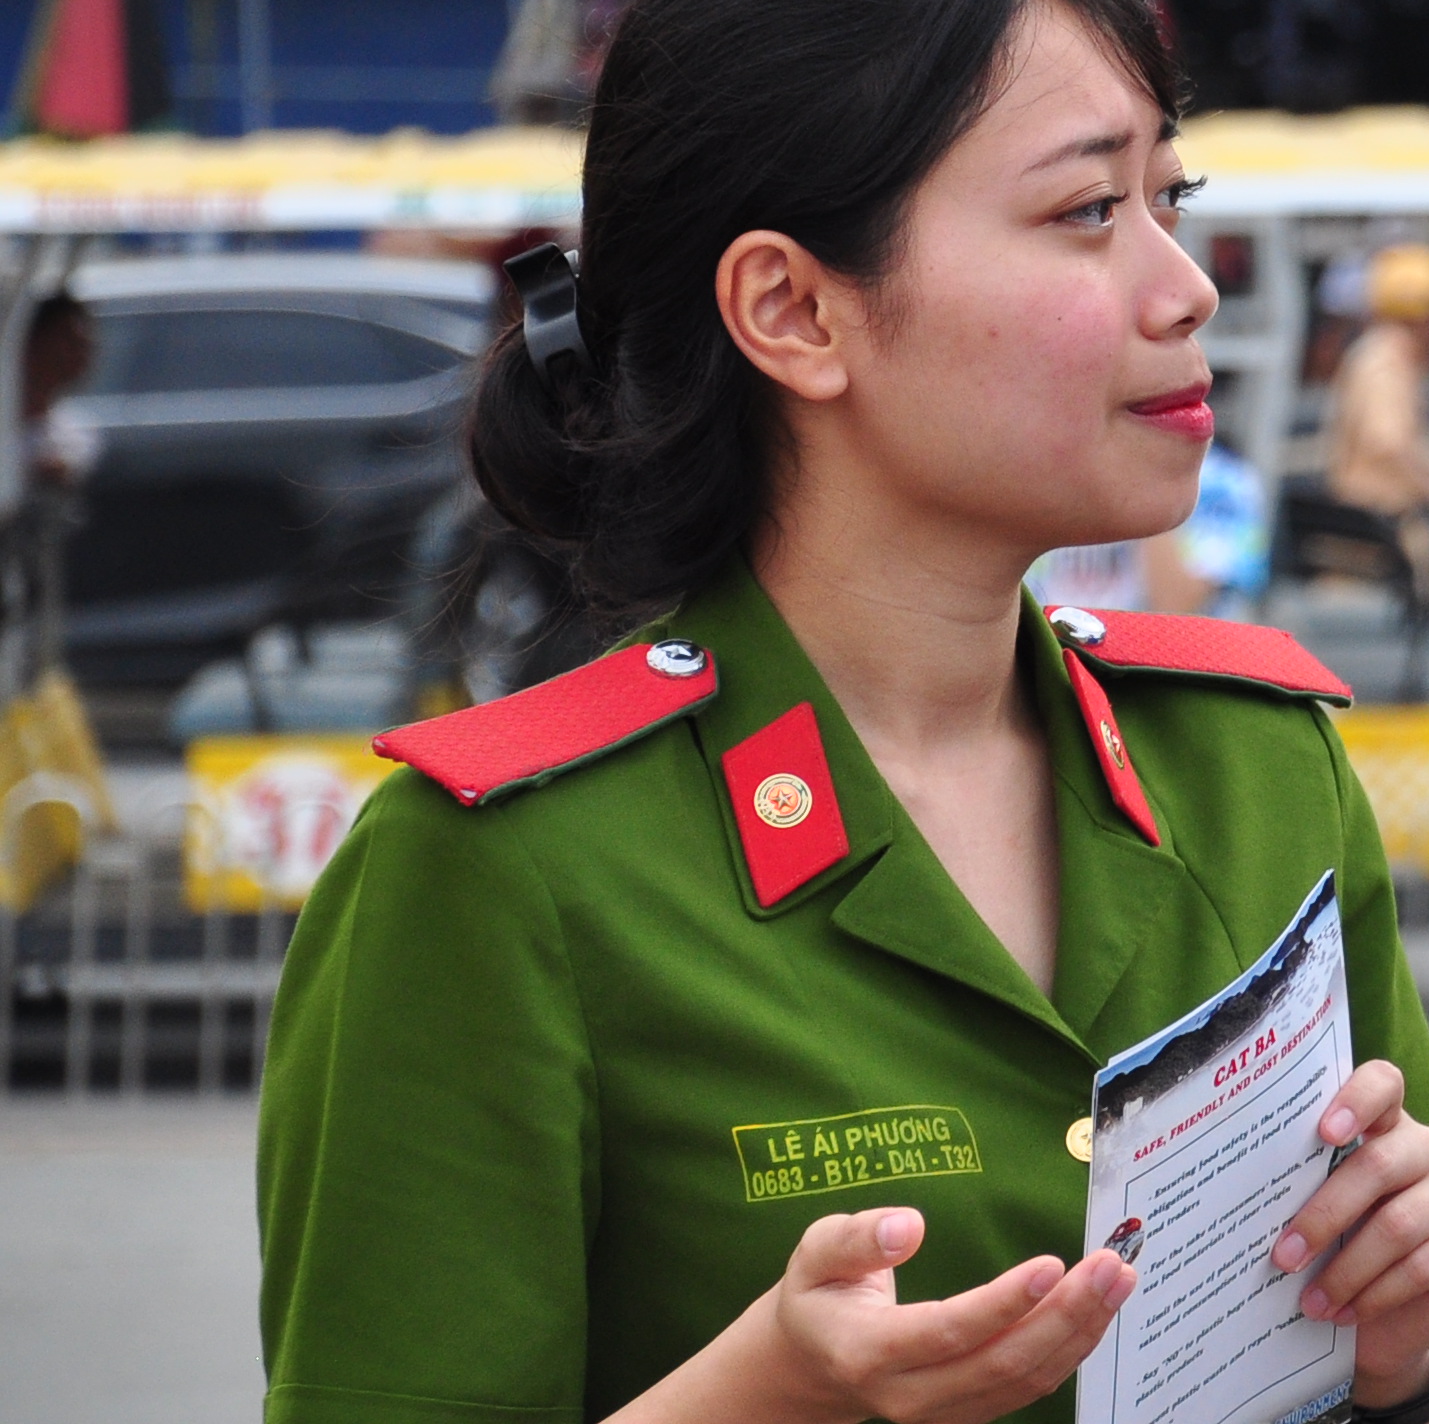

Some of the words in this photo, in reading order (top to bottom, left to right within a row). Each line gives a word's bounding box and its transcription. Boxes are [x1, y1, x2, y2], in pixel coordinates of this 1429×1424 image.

[1133, 1136, 1166, 1162] SAFE,
[1170, 1093, 1226, 1140] FRIENDLY
[1228, 1075, 1251, 1101] AND
[1253, 1055, 1278, 1081] COSY
[1280, 994, 1333, 1060] DESTINATION
[1213, 1047, 1250, 1087] CAT
[1254, 1028, 1277, 1058] BA
[752, 1166, 804, 1197] 0683
[825, 1155, 869, 1186] B12
[888, 1149, 926, 1174] D41
[940, 1145, 976, 1169] T32
[768, 1130, 805, 1163] LÊ
[813, 1127, 839, 1157] ÁI
[845, 1117, 950, 1151] PHƯƠNG
[1147, 1185, 1194, 1221] obligation
[1197, 1170, 1214, 1188] and
[1217, 1147, 1248, 1174] benefit
[1250, 1138, 1259, 1151] of
[1262, 1123, 1281, 1145] food
[1283, 1090, 1322, 1129] producers
[1154, 1166, 1196, 1199] Ensuring
[1199, 1149, 1219, 1172] food
[1221, 1131, 1248, 1153] safety
[1250, 1123, 1258, 1133] is
[1260, 1111, 1274, 1126] the
[1143, 1280, 1159, 1295] use
[1161, 1262, 1182, 1284] food
[1183, 1232, 1225, 1267] materials
[1227, 1222, 1237, 1235] of
[1238, 1206, 1261, 1226] clear
[1263, 1185, 1291, 1207] origin
[1146, 1221, 1164, 1240] and
[1167, 1199, 1200, 1226] traders
[1150, 1258, 1166, 1273] For
[1169, 1245, 1184, 1262] the
[1186, 1228, 1206, 1248] sake
[1208, 1219, 1217, 1232] of
[1305, 1146, 1325, 1164] only
[1138, 1330, 1162, 1351] sales
[1164, 1315, 1180, 1333] and
[1182, 1273, 1238, 1319] consumption
[1239, 1261, 1248, 1275] of
[1250, 1246, 1270, 1269] food
[1146, 1305, 1170, 1328] Limit
[1173, 1294, 1187, 1310] the
[1190, 1280, 1204, 1296] use
[1206, 1271, 1215, 1285] of
[1216, 1249, 1246, 1277] plastic
[1247, 1233, 1268, 1252] bags
[1270, 1226, 1279, 1236] in
[1135, 1379, 1165, 1407] plastic
[1166, 1349, 1204, 1383] products
[1142, 1367, 1159, 1383] Say
[1185, 1339, 1194, 1350] to
[1196, 1315, 1225, 1343] plastic
[1226, 1299, 1245, 1318] bags
[1247, 1284, 1265, 1302] and
[1171, 1383, 1201, 1411] plastic
[1203, 1362, 1228, 1386] waste
[1230, 1346, 1246, 1365] and
[1247, 1328, 1271, 1351] repel
